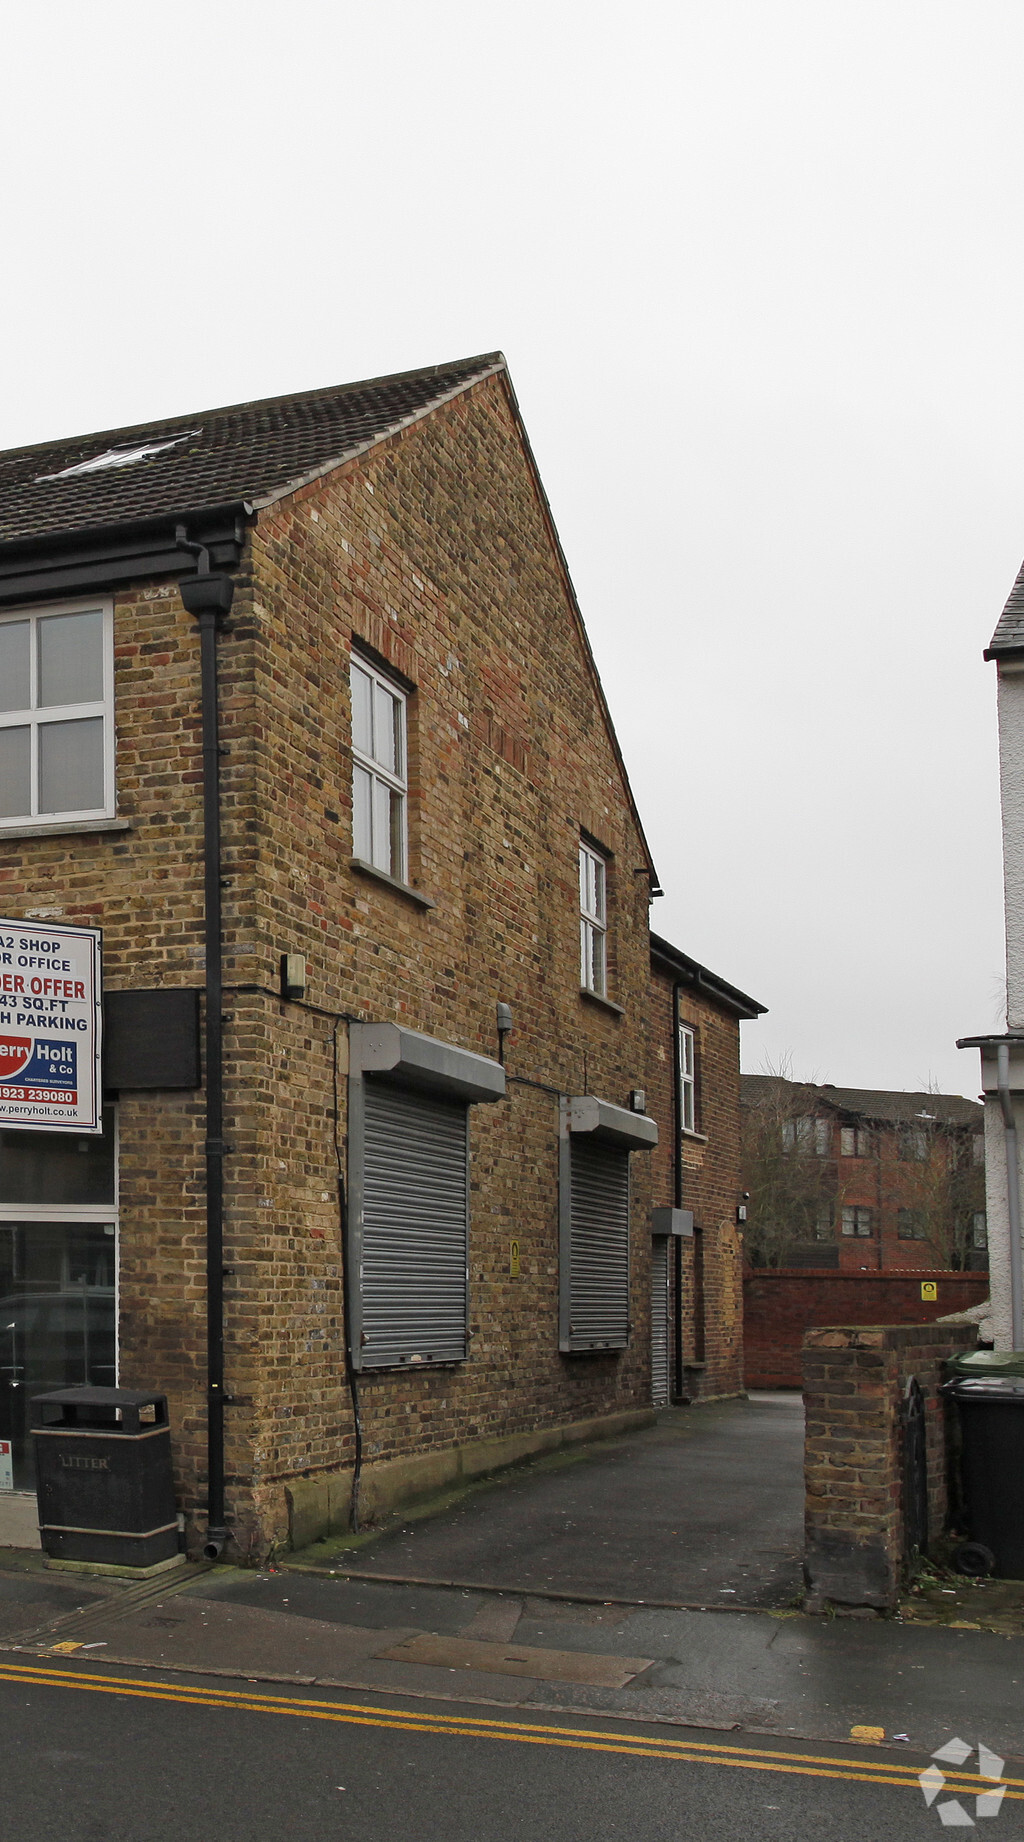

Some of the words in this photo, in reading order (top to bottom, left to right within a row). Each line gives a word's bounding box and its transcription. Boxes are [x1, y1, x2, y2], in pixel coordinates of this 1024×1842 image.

[19, 938, 61, 953] SHOP
[18, 956, 71, 972] OFFICE
[30, 977, 86, 999] OFFER
[22, 996, 68, 1012] SQ.FT
[16, 1014, 88, 1031] PARKING
[36, 1044, 73, 1062] Holt
[50, 1064, 56, 1073] &
[59, 1065, 73, 1074] Co
[28, 1089, 73, 1102] 239080
[62, 1456, 108, 1469] LITTER
